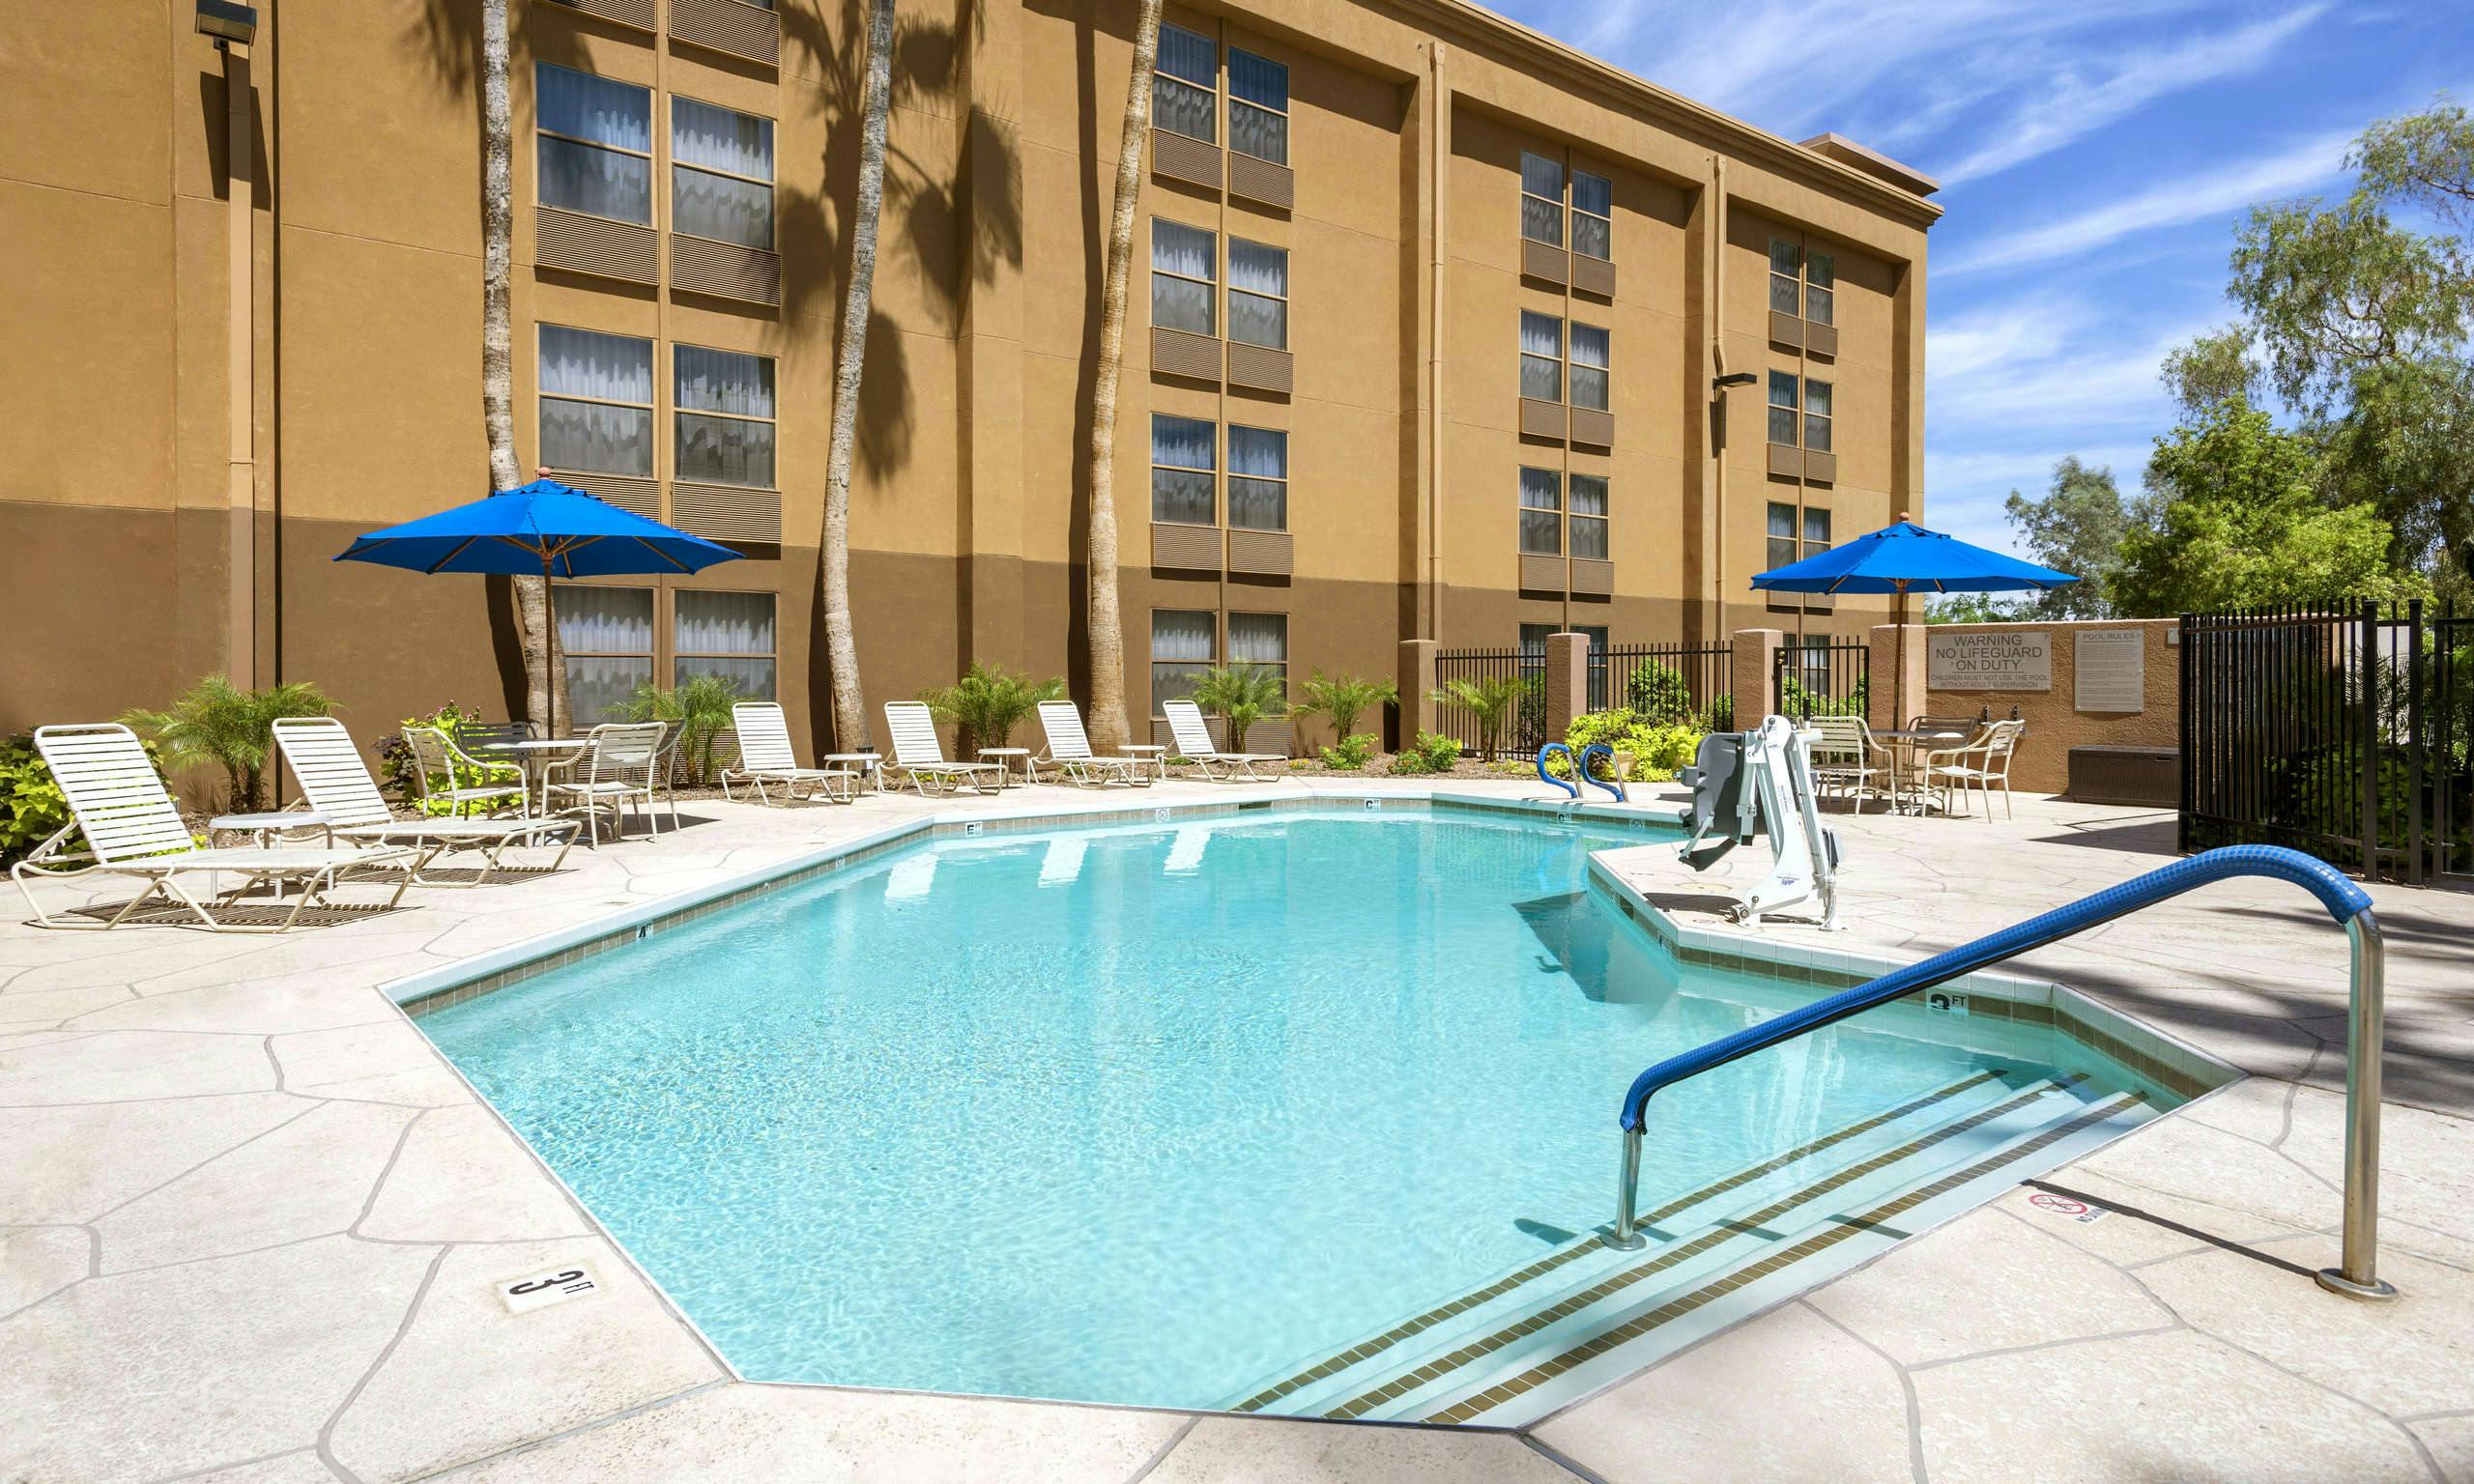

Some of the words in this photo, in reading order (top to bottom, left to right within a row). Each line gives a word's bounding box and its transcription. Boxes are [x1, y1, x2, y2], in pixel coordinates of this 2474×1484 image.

[1954, 634, 2023, 646] WARNING
[1936, 648, 1956, 659] NO
[1961, 646, 2042, 659] LIFEGUARD
[1956, 660, 1976, 671] ON
[1981, 659, 2022, 671] DUTY
[1952, 996, 1967, 1006] FT
[508, 1270, 585, 1296] 3
[561, 1281, 595, 1295] FT
